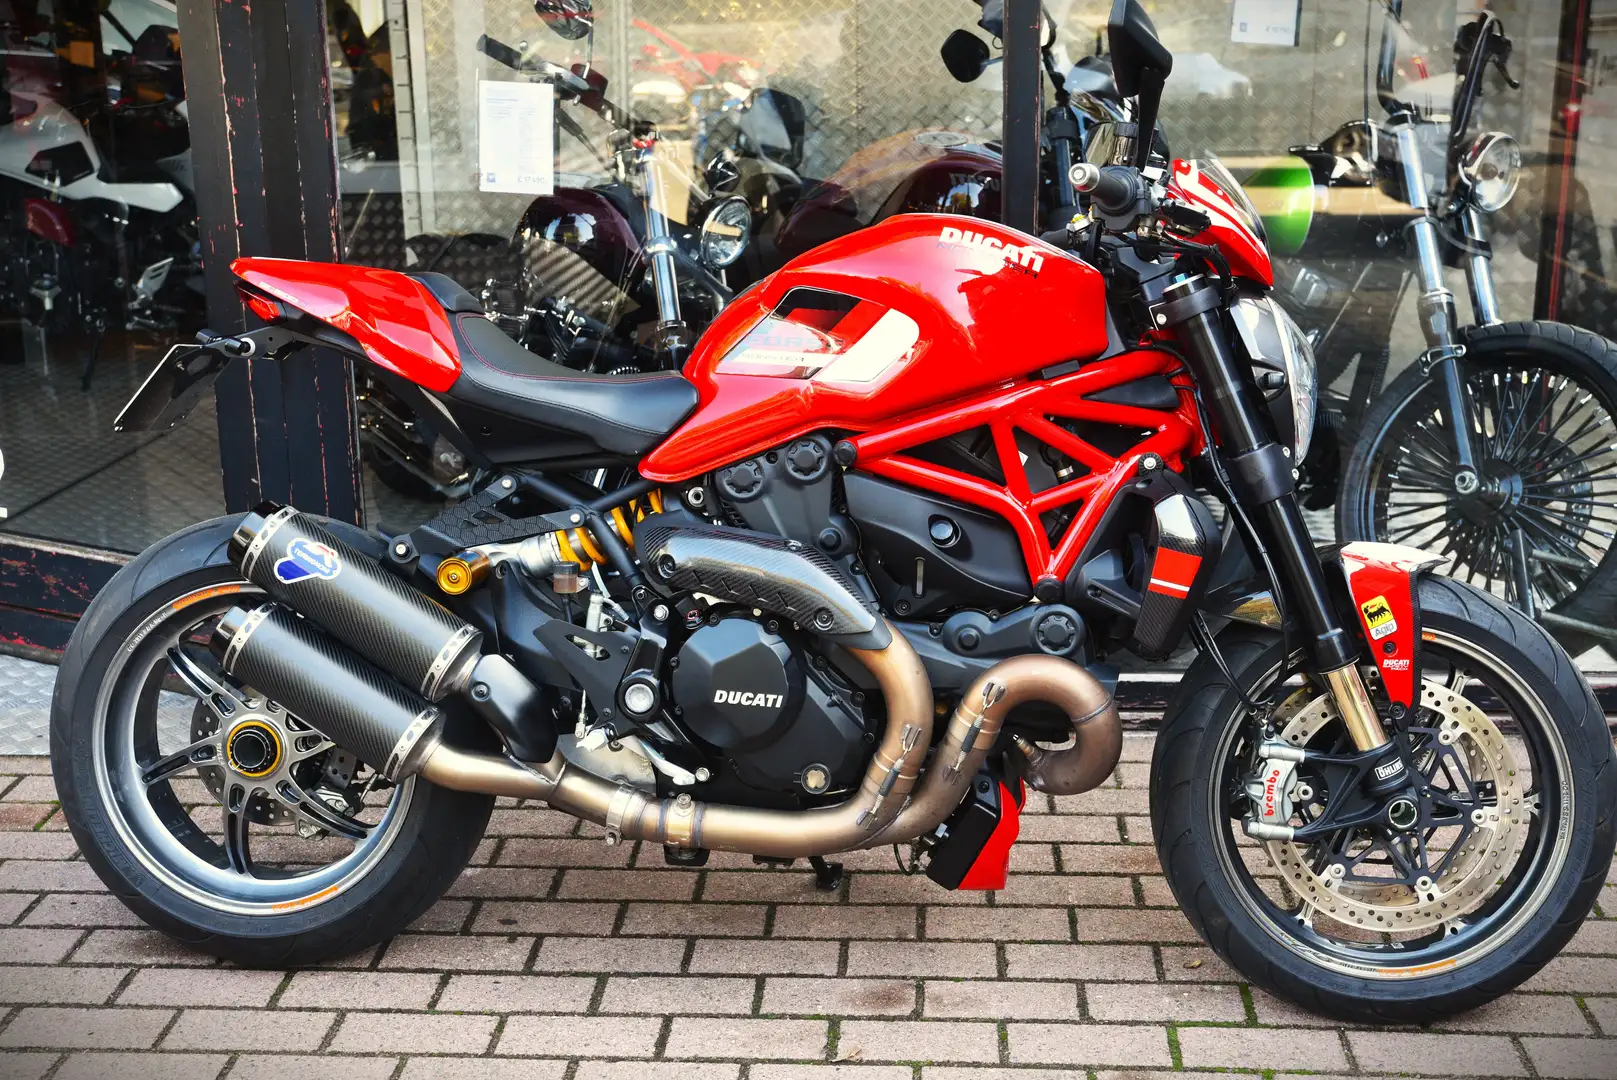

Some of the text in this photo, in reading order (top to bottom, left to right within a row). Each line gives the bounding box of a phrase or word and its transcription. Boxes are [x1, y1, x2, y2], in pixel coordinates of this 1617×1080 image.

[938, 226, 1044, 273] DUCATI
[1373, 623, 1395, 637] Agip
[1382, 659, 1410, 668] DUCATI
[713, 689, 784, 709] DUCATI
[1264, 769, 1280, 817] brembo
